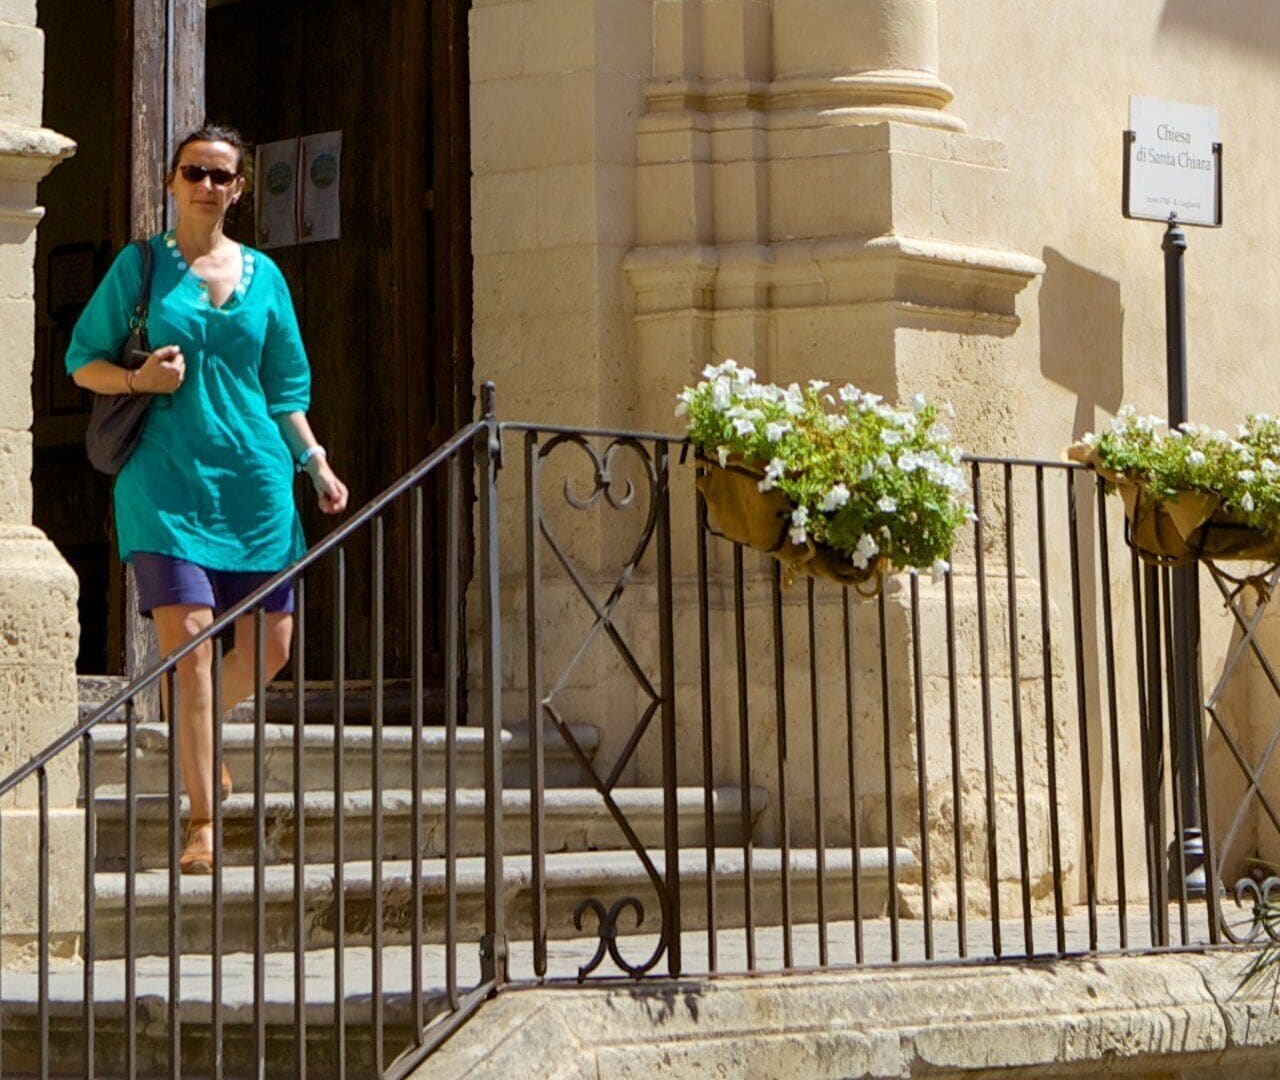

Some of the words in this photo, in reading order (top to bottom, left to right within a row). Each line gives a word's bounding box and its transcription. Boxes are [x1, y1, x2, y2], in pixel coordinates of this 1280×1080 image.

[1156, 123, 1191, 143] Chiesa
[1136, 146, 1147, 162] di
[1148, 147, 1176, 166] Santa
[1178, 151, 1211, 171] Chiara
